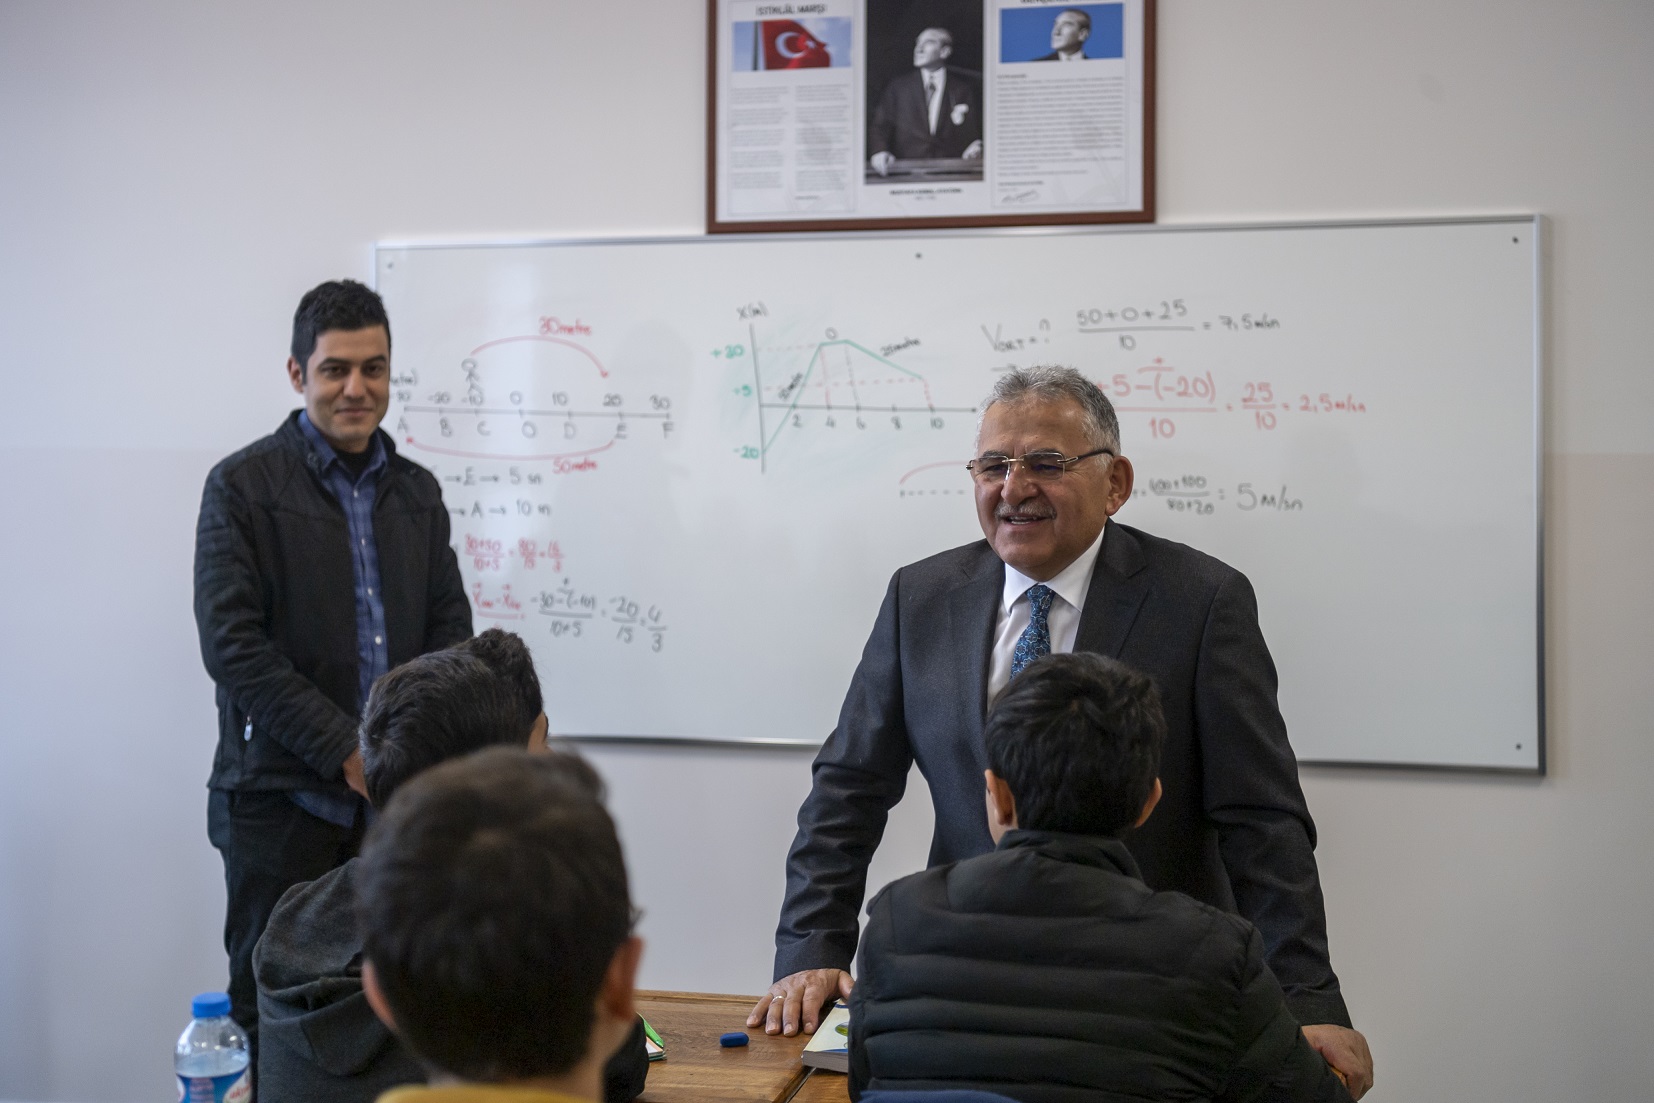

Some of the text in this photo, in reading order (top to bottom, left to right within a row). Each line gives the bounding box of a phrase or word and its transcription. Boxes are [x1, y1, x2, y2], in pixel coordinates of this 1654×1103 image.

[1118, 334, 1137, 351] 10
[551, 392, 568, 406] 10
[1241, 381, 1274, 402] 25
[930, 415, 945, 430] 10
[1149, 417, 1176, 439] 10
[1254, 411, 1277, 431] 10
[470, 500, 484, 519] A
